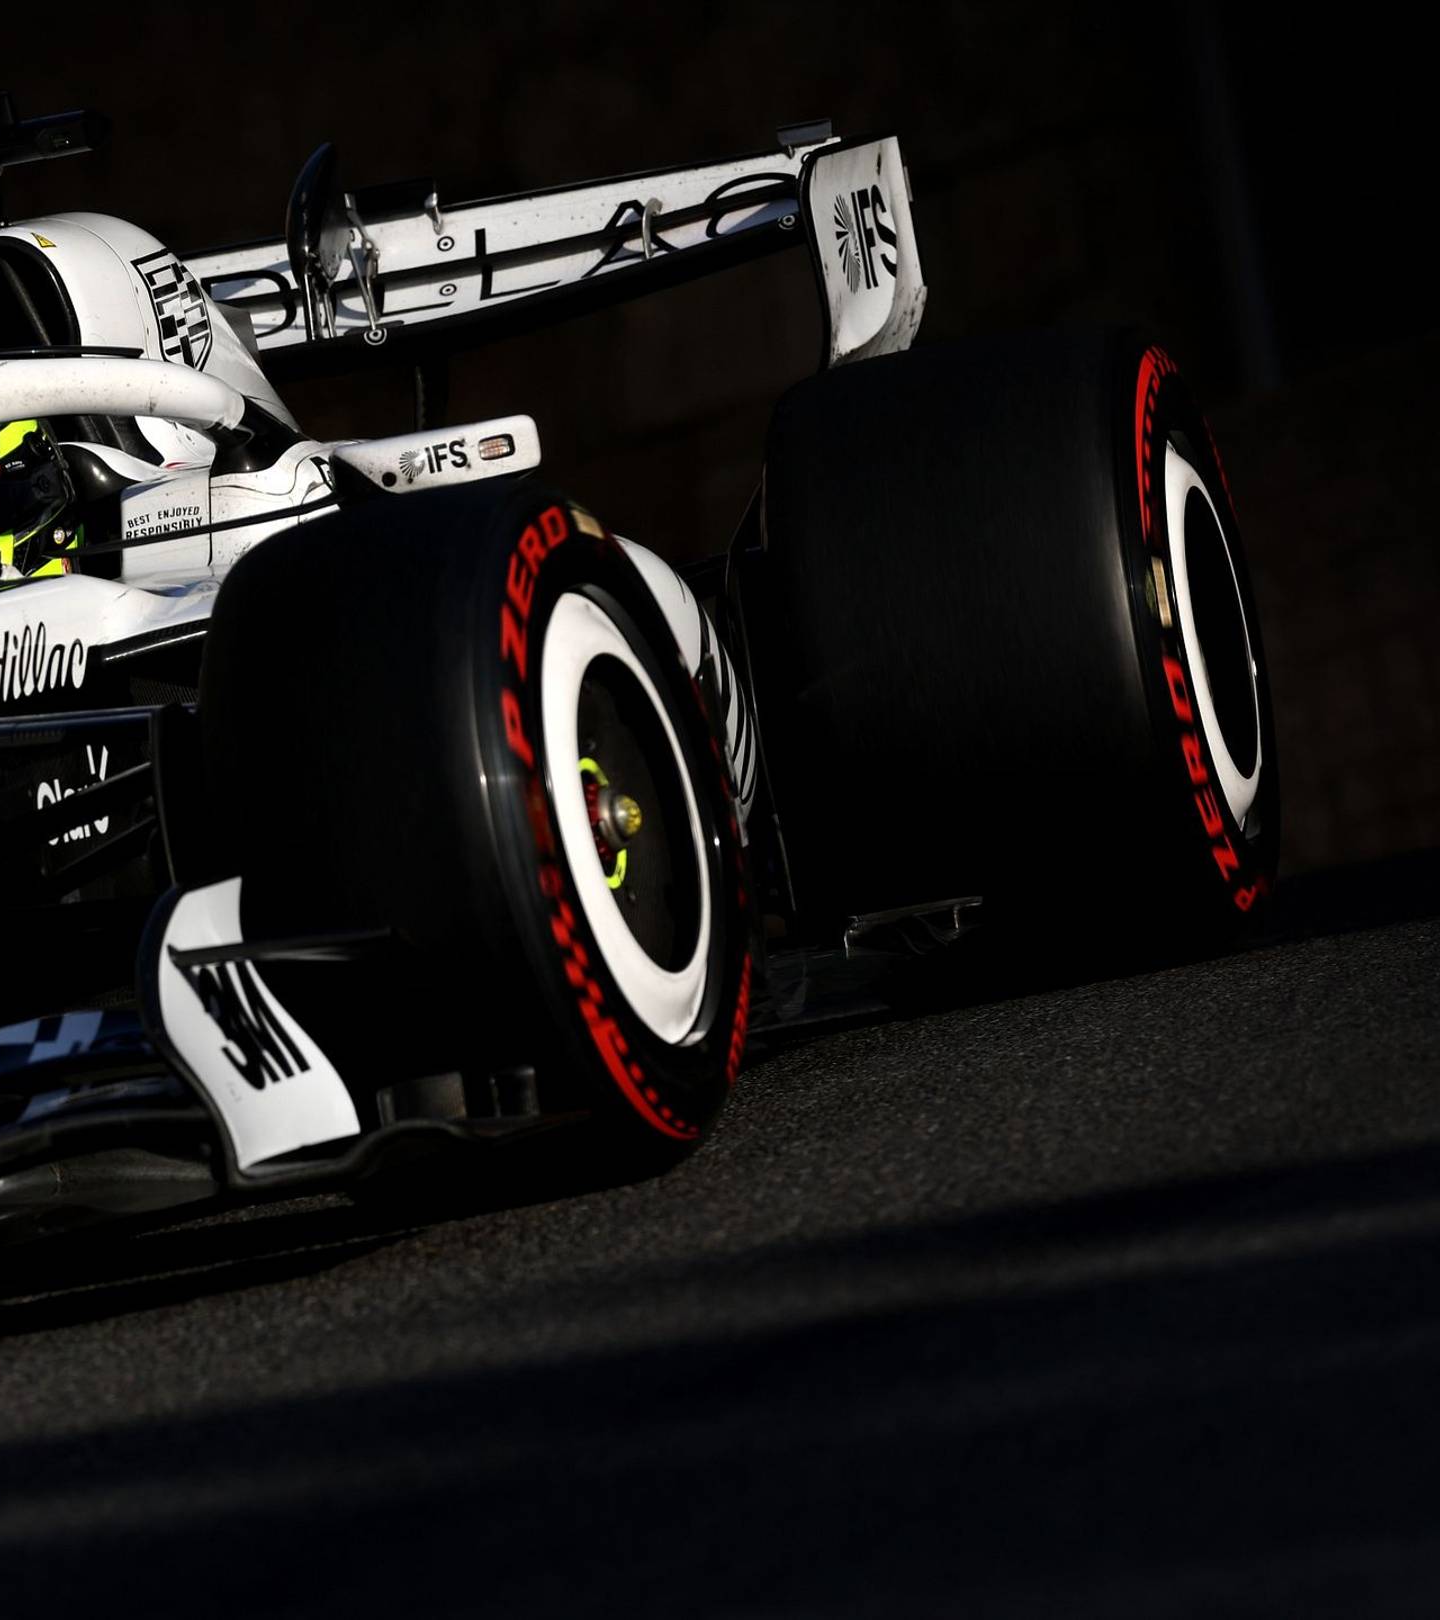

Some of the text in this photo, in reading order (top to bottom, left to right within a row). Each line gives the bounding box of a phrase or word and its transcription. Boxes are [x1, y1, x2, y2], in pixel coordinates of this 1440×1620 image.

[850, 184, 898, 290] IFS
[424, 438, 469, 475] IFS
[127, 505, 201, 529] BEST ENJOYED
[499, 502, 571, 687] ZERO
